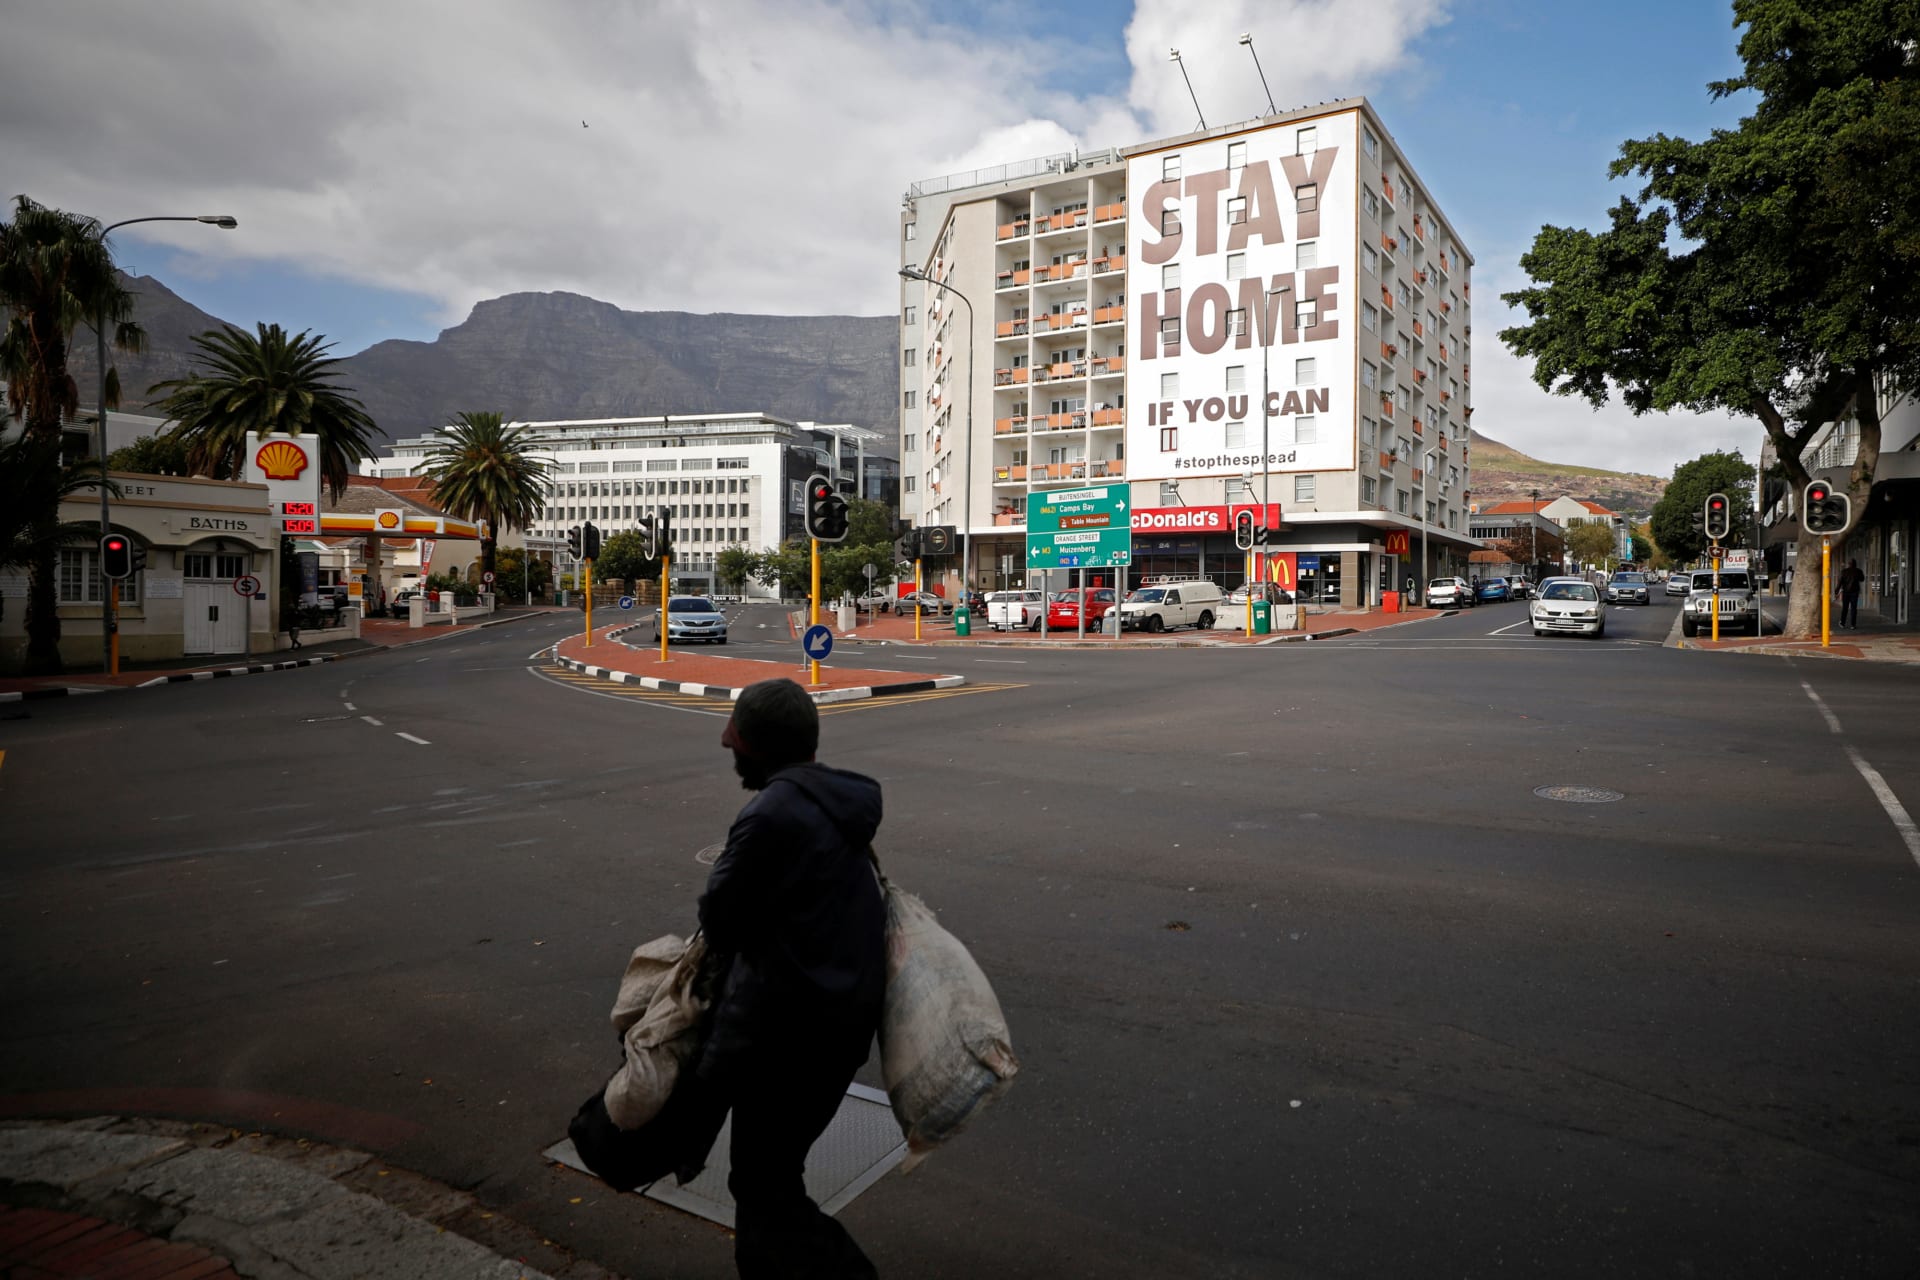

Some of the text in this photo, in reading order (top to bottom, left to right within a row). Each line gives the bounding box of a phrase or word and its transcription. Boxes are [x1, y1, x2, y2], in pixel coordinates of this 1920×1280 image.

[1141, 146, 1340, 265] STAY
[1140, 265, 1340, 360] HOME
[1148, 387, 1330, 426] IF YOU CAN
[1058, 492, 1095, 501] BUITENSINGEL
[1059, 504, 1080, 513] Camps
[1082, 503, 1095, 512] Bay
[190, 517, 248, 530] BATHS
[1085, 516, 1109, 524] Mountain
[1056, 533, 1098, 543] ORANGE STREET
[1042, 545, 1096, 554] M3 Muizenberg
